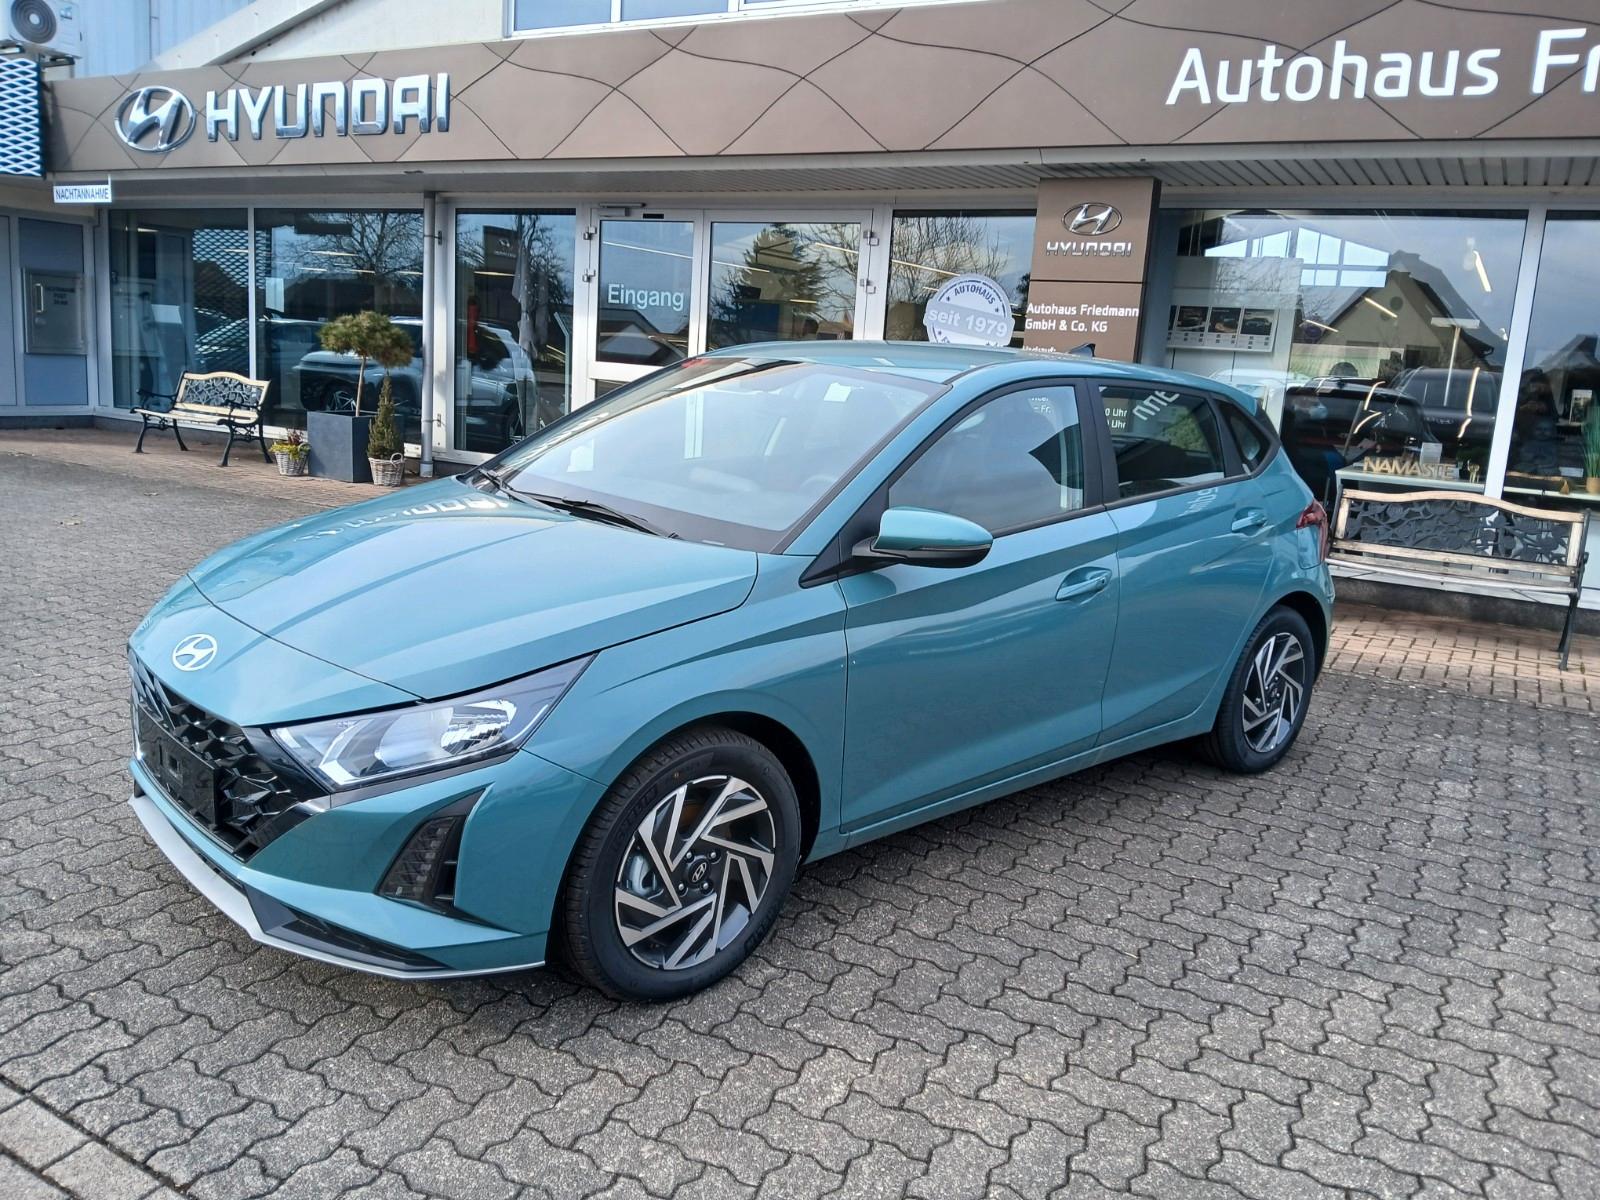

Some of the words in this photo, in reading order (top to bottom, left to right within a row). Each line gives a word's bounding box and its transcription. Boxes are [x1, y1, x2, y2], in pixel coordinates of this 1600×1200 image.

[1165, 40, 1501, 106] Autohaus
[206, 73, 450, 142] HYUNDAI
[55, 187, 109, 201] NACHTANNAHME
[1046, 241, 1132, 257] HYUNDAI
[607, 283, 684, 312] Eingang
[954, 284, 996, 304] AUTOHAUS
[1026, 303, 1077, 315] Autohaus
[1080, 304, 1140, 317] Friedmann
[928, 309, 961, 326] seit
[966, 315, 1008, 338] 1979
[1025, 319, 1057, 331] GmbH
[1059, 320, 1068, 331] &
[1071, 321, 1088, 332] Co.
[1091, 321, 1108, 333] KG
[1363, 456, 1457, 479] NAMASTE
